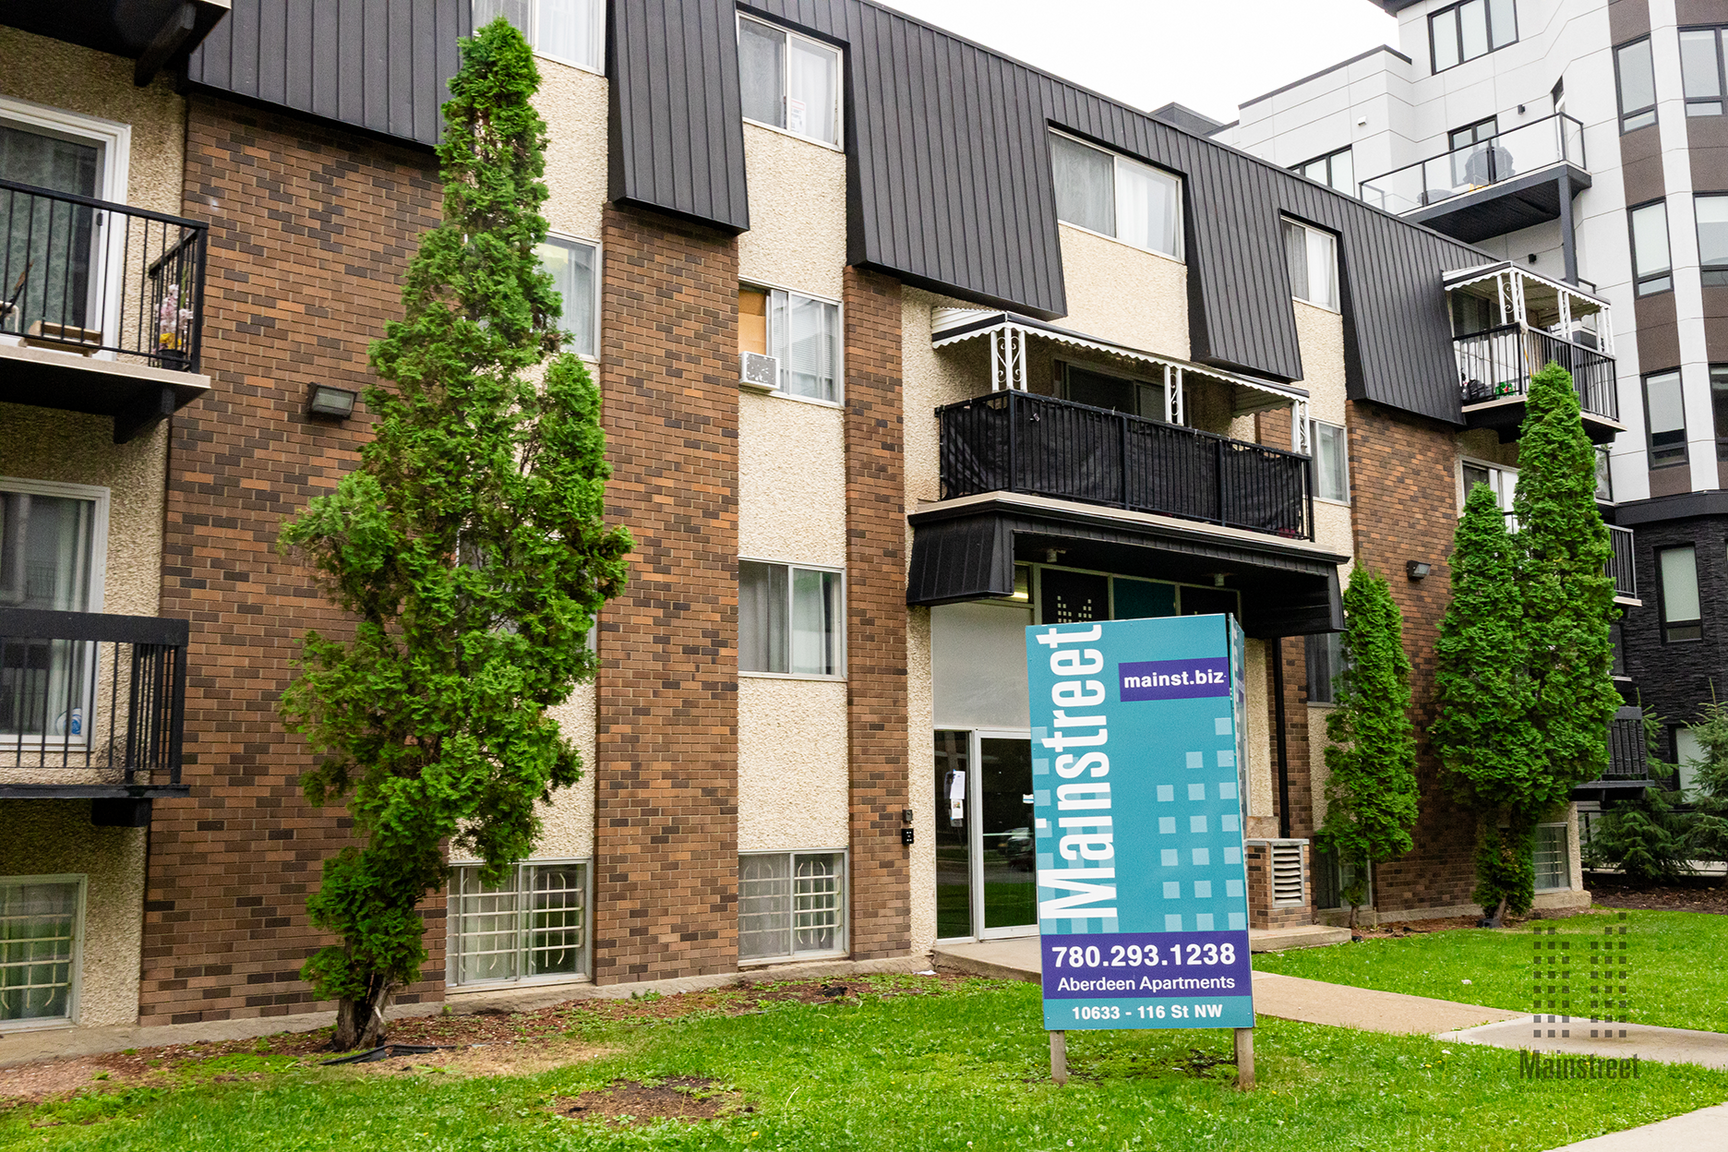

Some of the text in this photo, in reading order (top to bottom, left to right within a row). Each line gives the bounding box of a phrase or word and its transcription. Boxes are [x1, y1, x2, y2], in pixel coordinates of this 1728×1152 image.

[1124, 669, 1225, 688] mainst.biz
[1036, 624, 1117, 919] Mainstreet
[1051, 943, 1236, 968] 780.293.1238
[1057, 976, 1236, 993] Aberdeen Apartments
[1072, 1006, 1121, 1020] 10633
[1137, 1005, 1166, 1019] 116
[1171, 1004, 1189, 1019] St
[1194, 1004, 1223, 1018] NW
